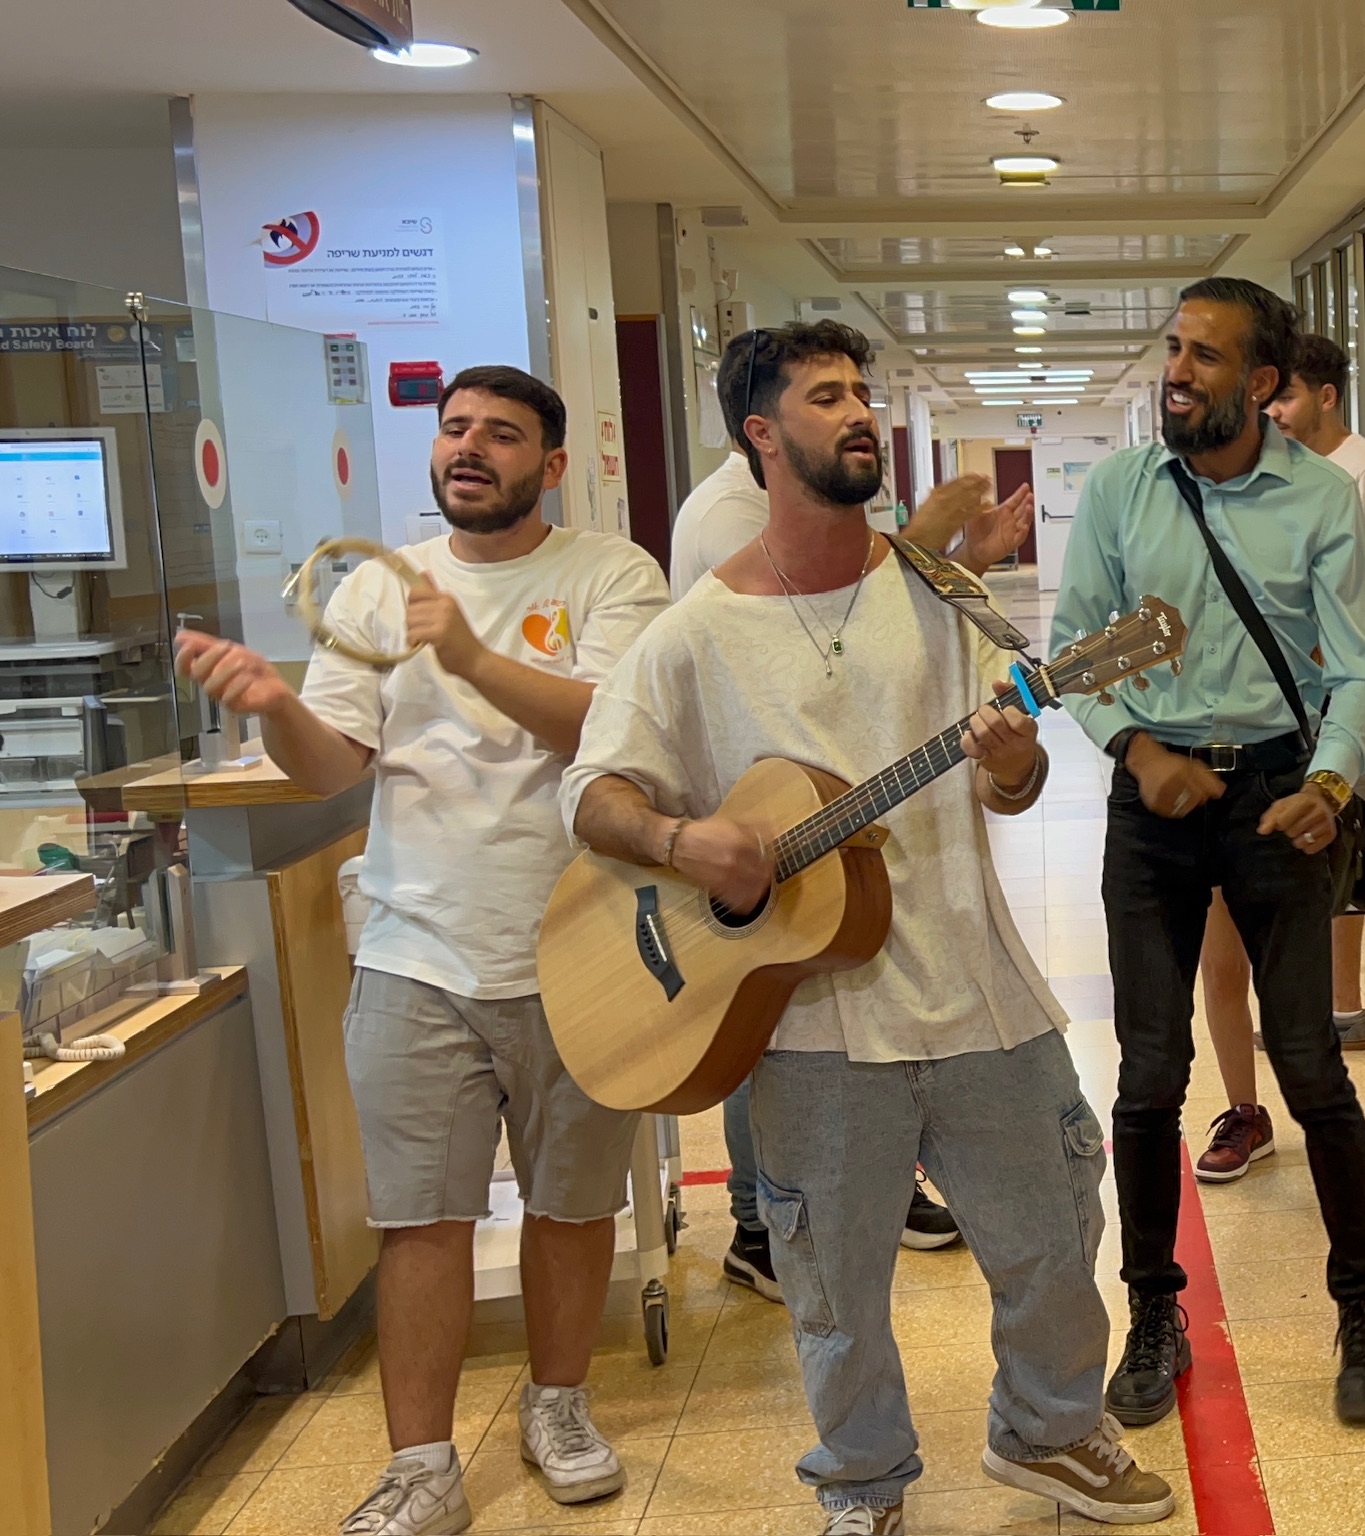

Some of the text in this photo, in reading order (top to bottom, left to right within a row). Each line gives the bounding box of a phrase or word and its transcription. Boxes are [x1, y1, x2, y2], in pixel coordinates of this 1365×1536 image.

[327, 247, 434, 258] דגשים למניעת שריפה
[9, 327, 60, 338] איכות
[66, 323, 96, 337] לוח
[12, 339, 52, 352] Safety
[55, 339, 95, 350] Board
[1156, 611, 1171, 637] Taylor
